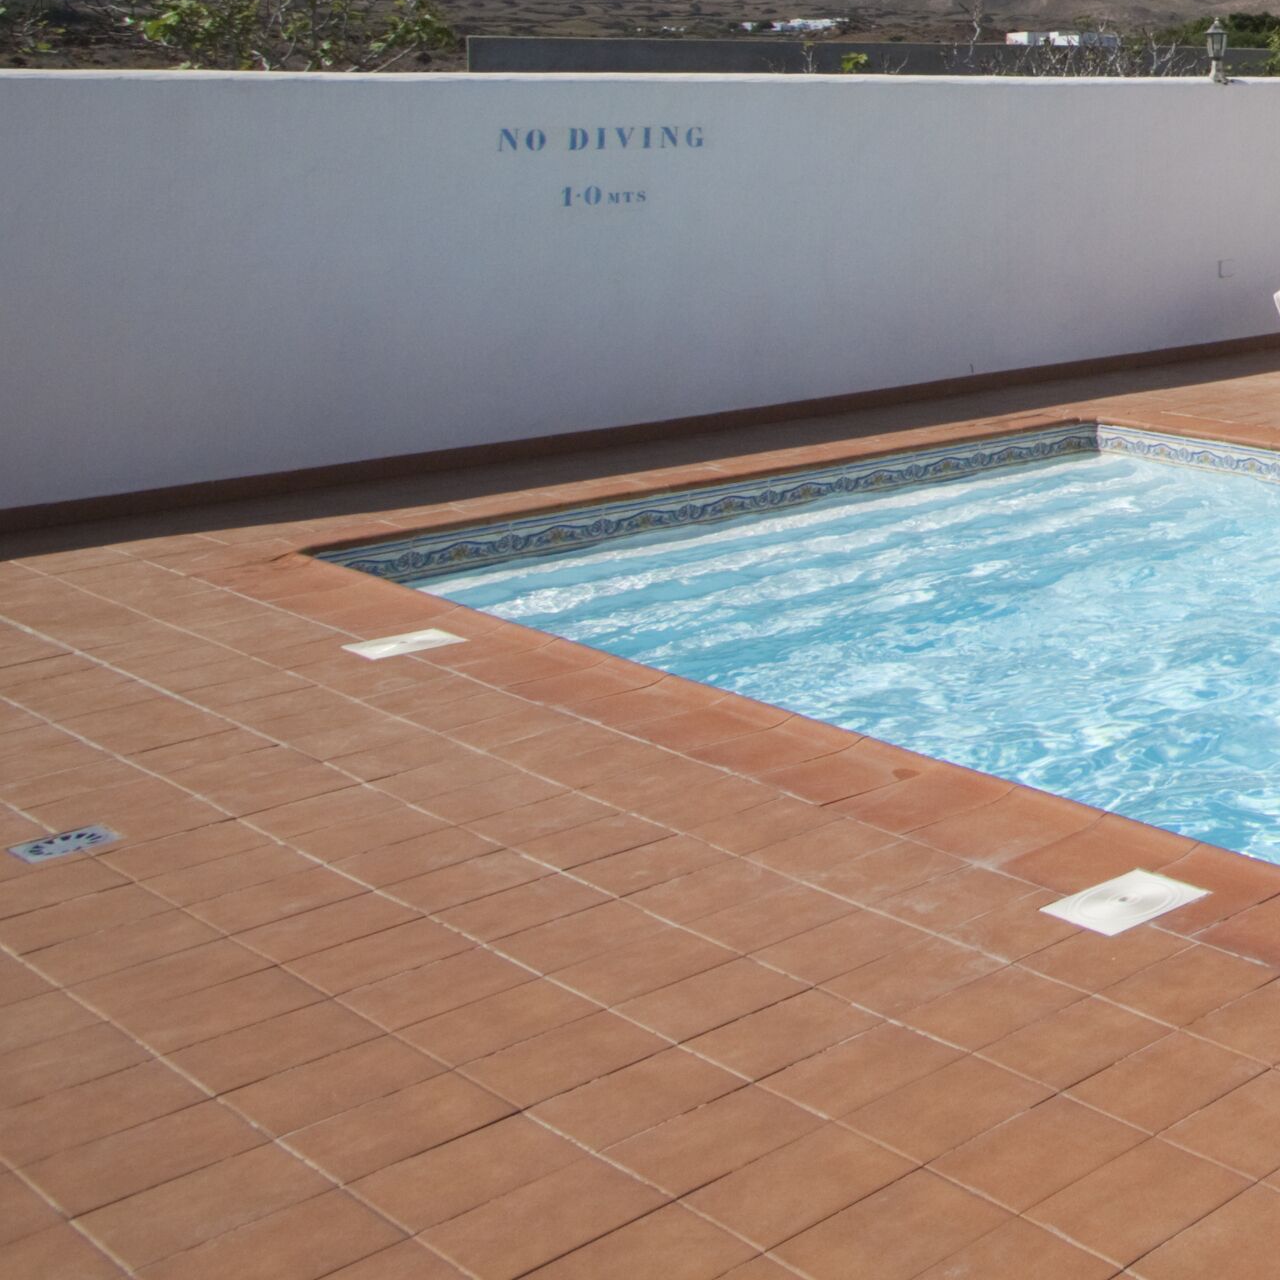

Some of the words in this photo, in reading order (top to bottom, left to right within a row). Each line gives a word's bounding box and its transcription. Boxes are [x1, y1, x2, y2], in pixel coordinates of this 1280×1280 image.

[497, 128, 547, 152] NO
[568, 126, 704, 151] DIVING
[607, 190, 647, 204] MTS
